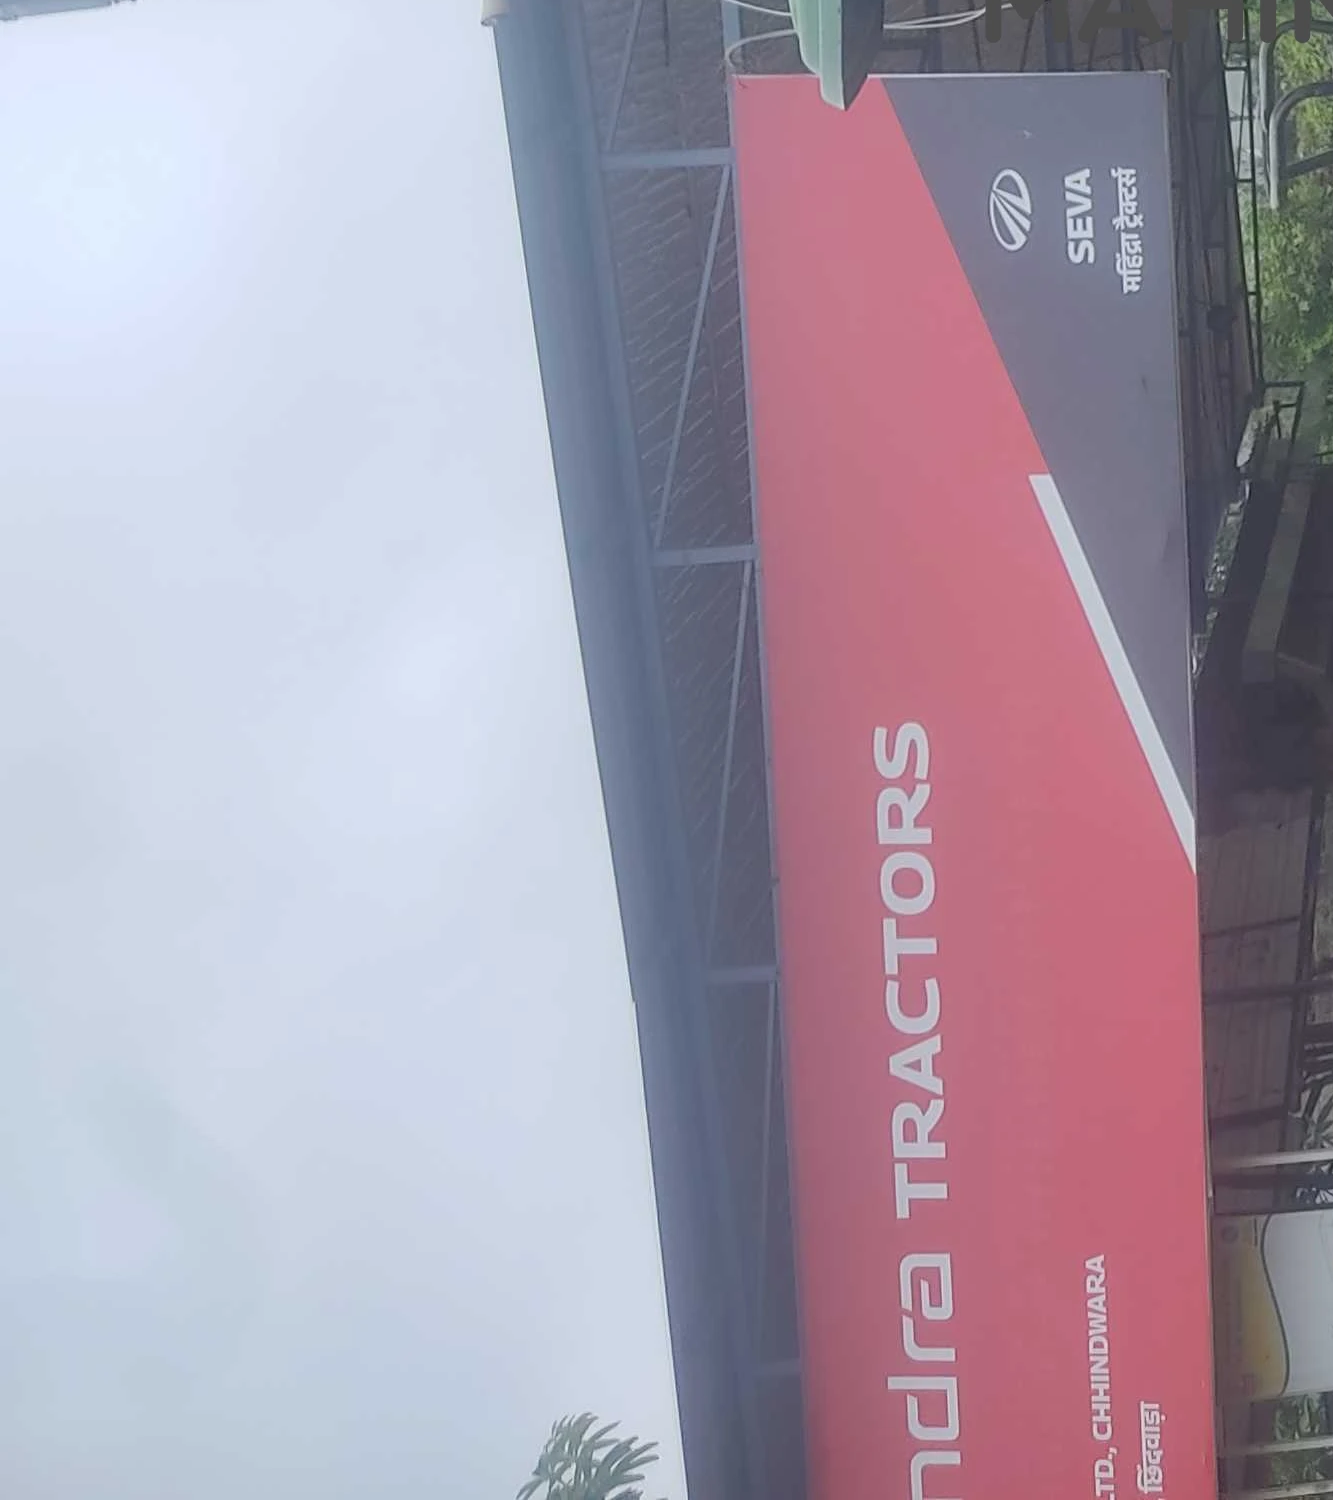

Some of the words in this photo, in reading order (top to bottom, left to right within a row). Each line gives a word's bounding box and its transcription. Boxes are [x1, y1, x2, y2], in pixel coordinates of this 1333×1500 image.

[1064, 167, 1095, 264] SEVA
[873, 721, 948, 1219] TRACTORS
[1085, 1254, 1113, 1441] CHHINDWARA
